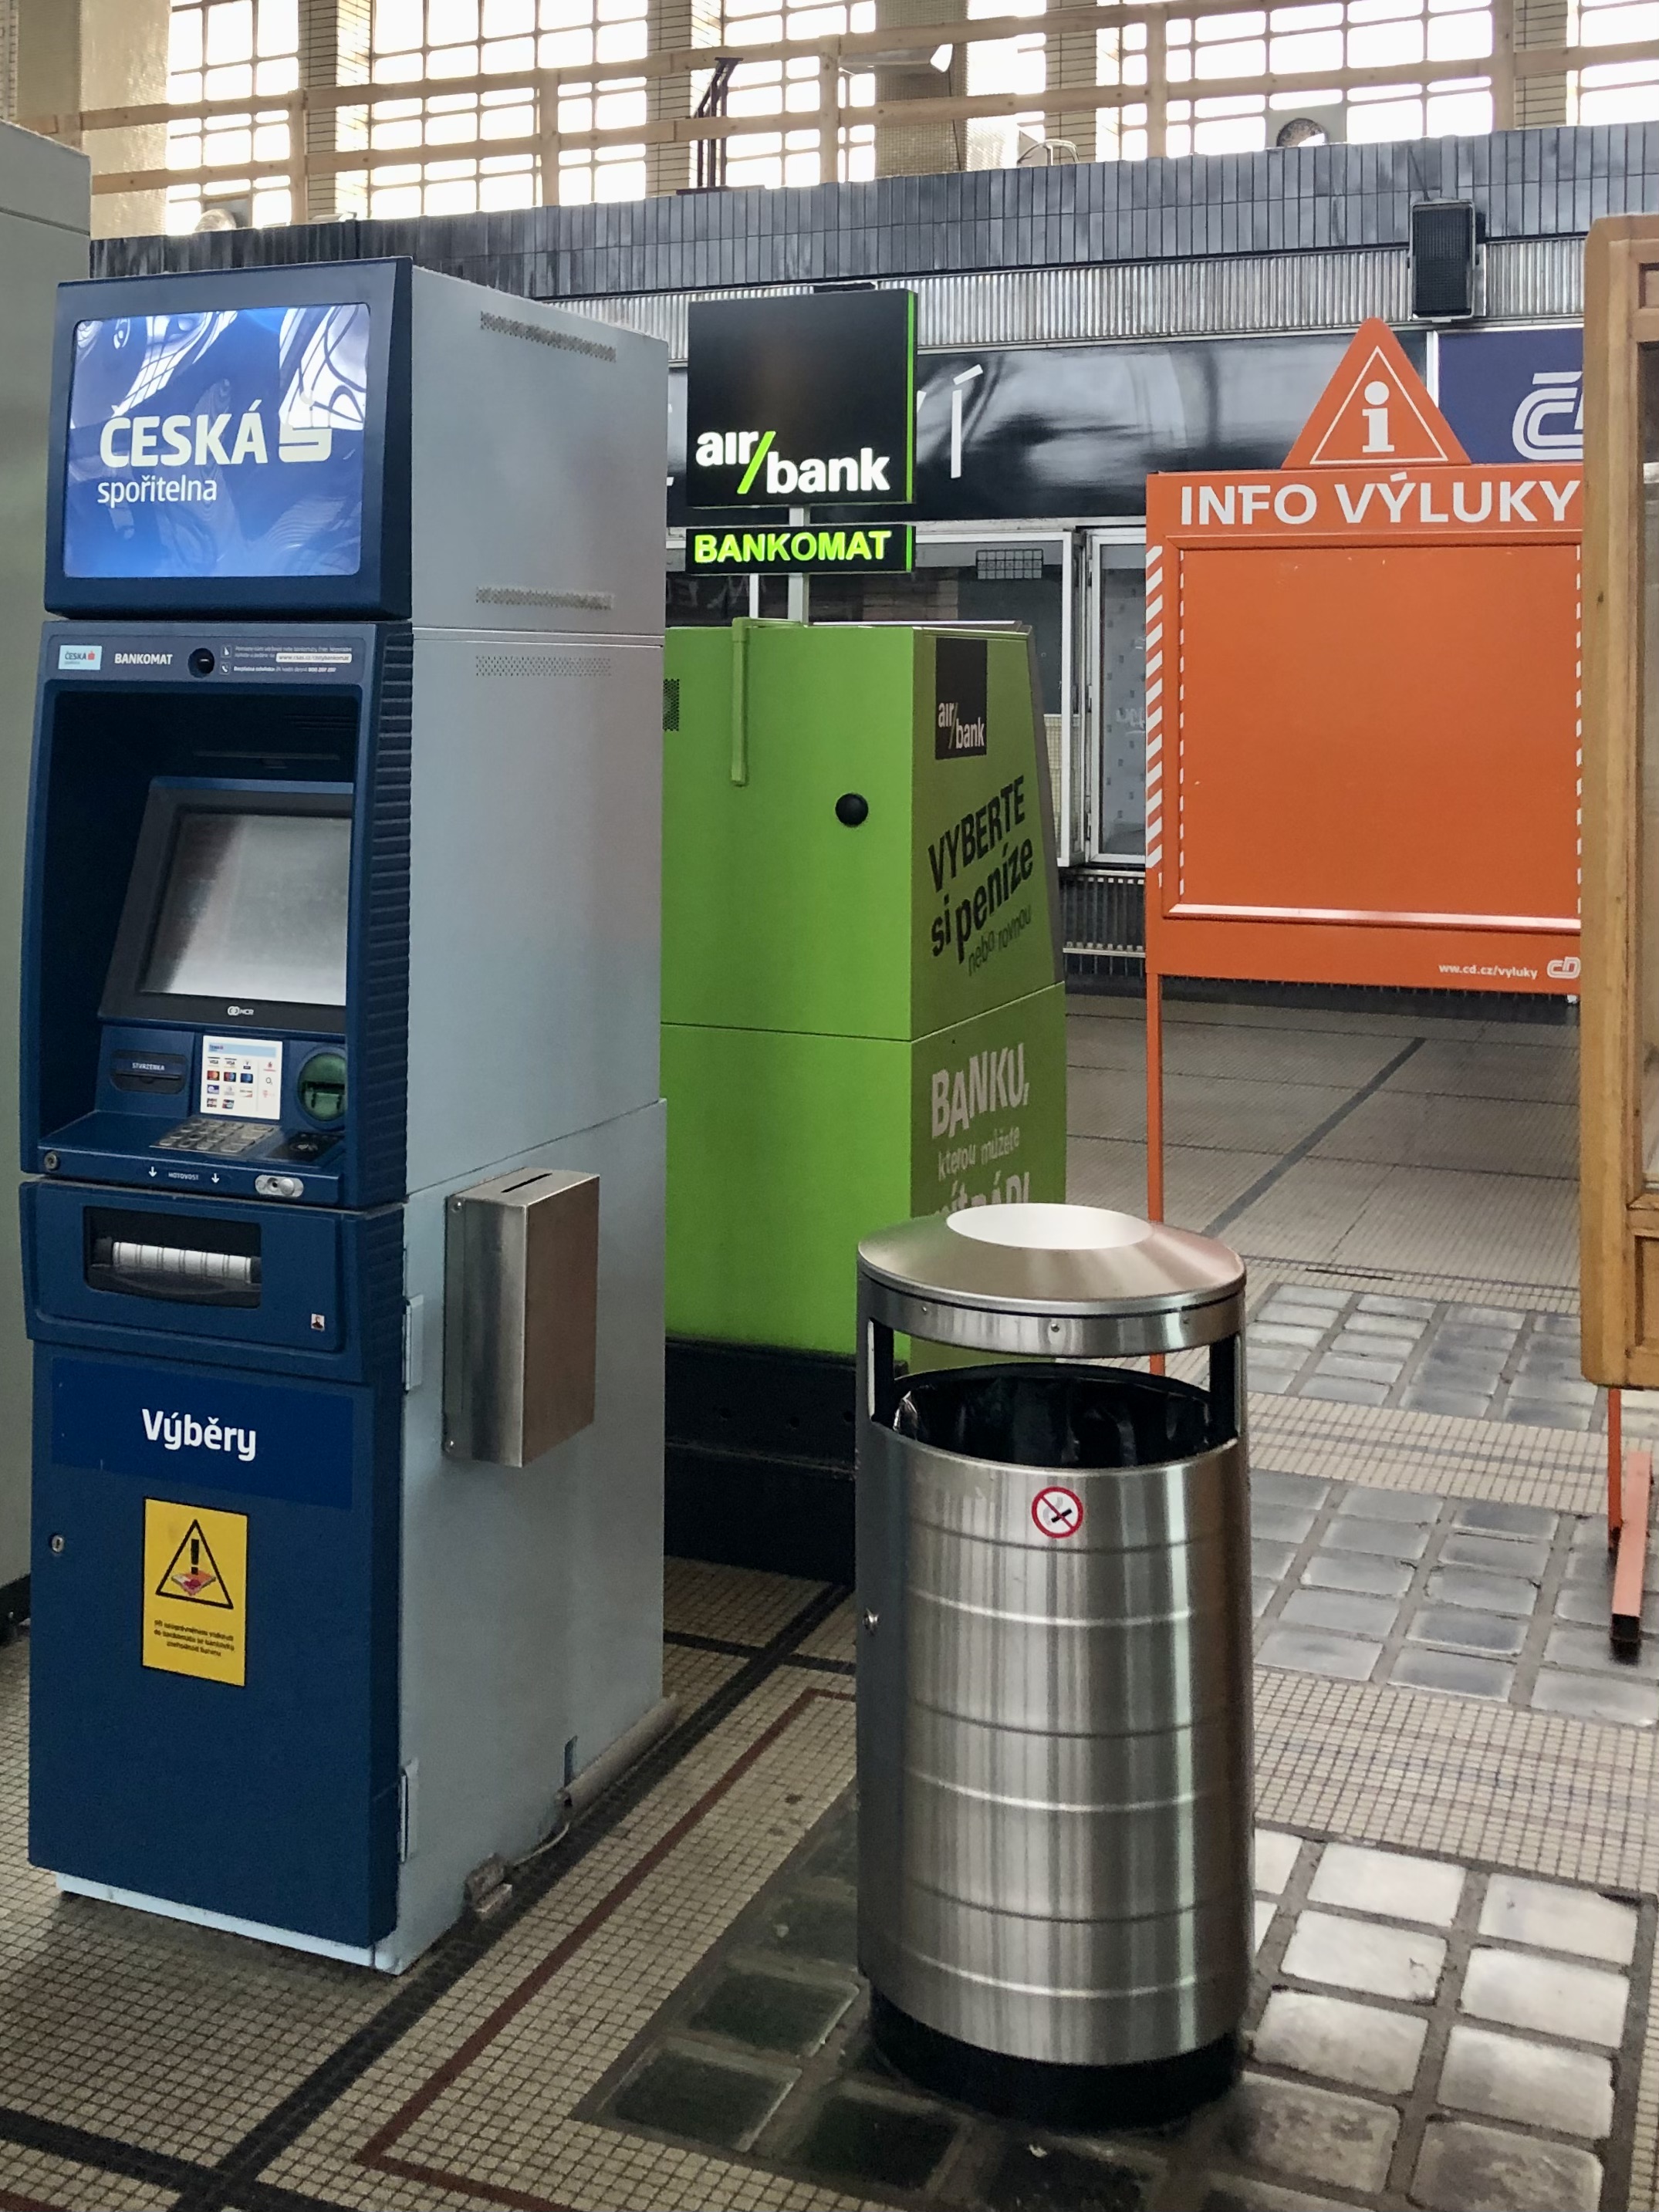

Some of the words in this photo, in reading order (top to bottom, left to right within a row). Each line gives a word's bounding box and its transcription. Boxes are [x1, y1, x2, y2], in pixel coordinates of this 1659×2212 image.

[100, 399, 268, 468] ČESKÁ
[97, 474, 218, 508] spořitelna
[1181, 484, 1317, 525] INFO
[1334, 472, 1580, 523] VÝLUKY
[694, 531, 891, 564] BANKOMAT
[114, 653, 173, 665] BANKOMAT
[928, 775, 1025, 893] VYBERTE
[931, 893, 951, 957] si
[955, 838, 1033, 964] peníze
[968, 930, 995, 977] nebo
[998, 905, 1032, 951] rovnou
[931, 1042, 1030, 1140] BANKU,
[938, 1144, 976, 1182] kterou
[141, 1408, 257, 1462] Výběry
